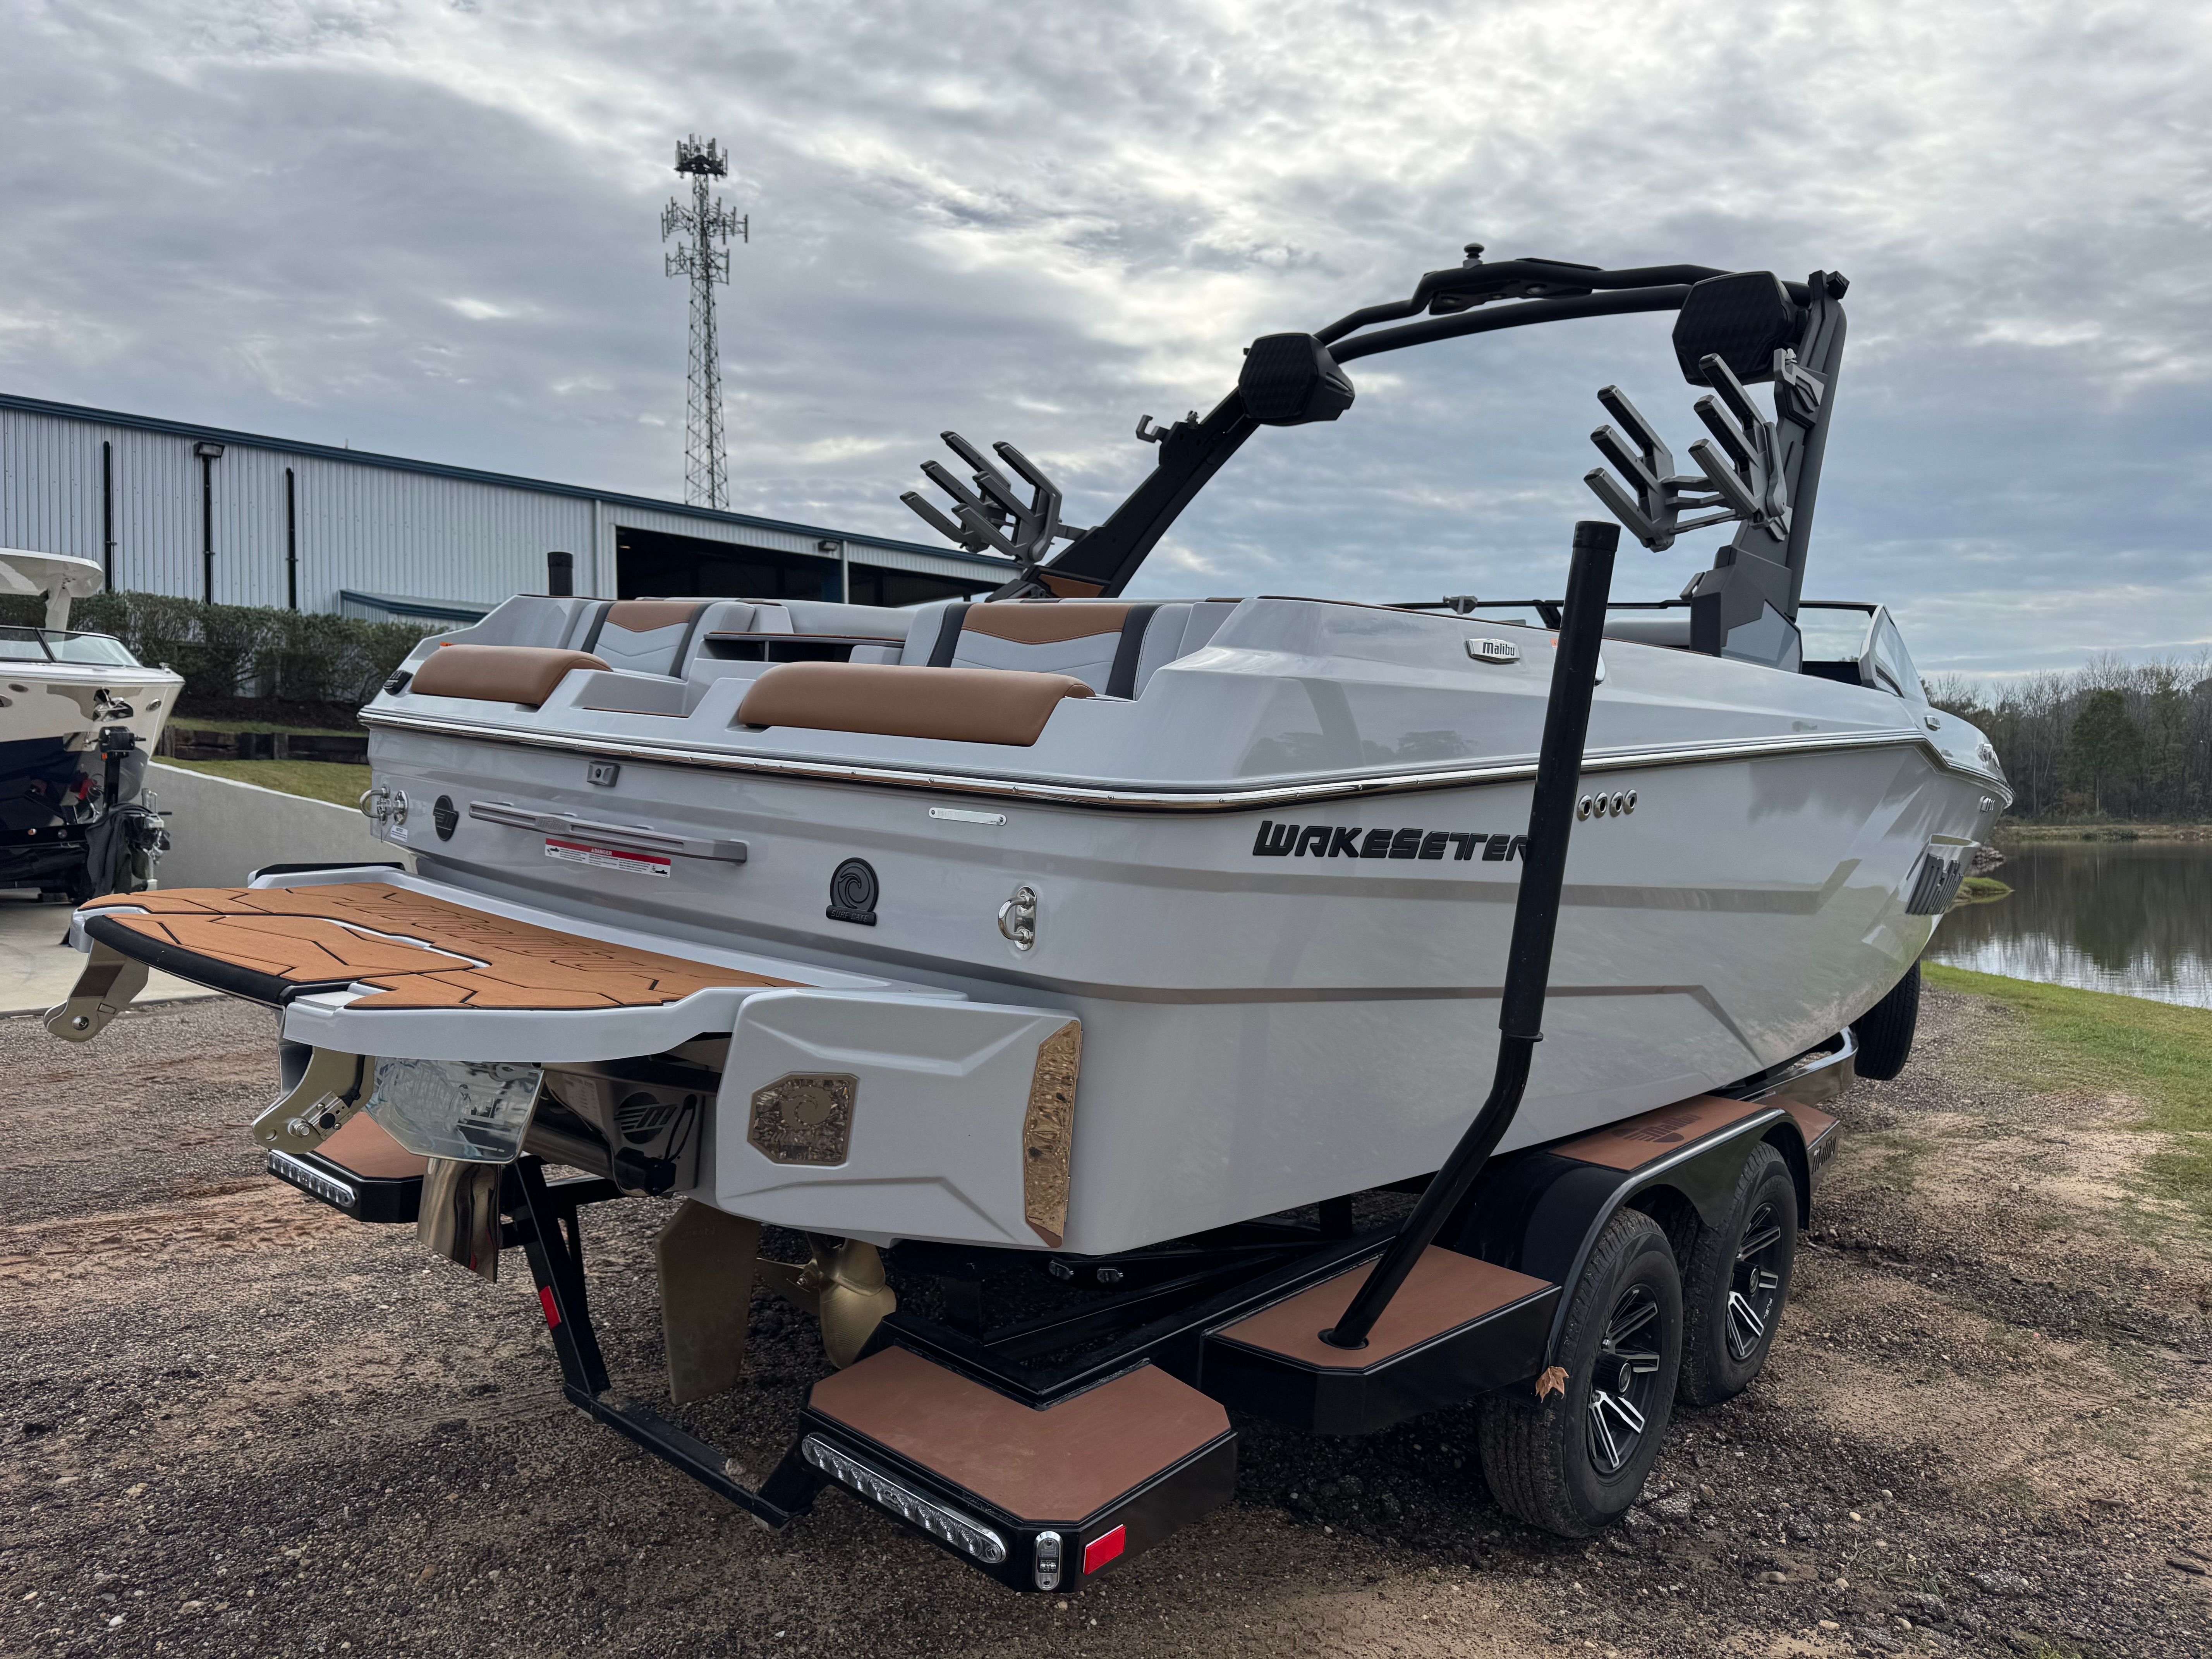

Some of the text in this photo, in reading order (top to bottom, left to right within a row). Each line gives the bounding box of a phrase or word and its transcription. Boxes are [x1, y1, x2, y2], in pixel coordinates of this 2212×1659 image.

[1482, 642, 1515, 656] Malibu
[1252, 820, 1528, 862] WAKESETTER
[830, 909, 869, 922] SURF GATE
[1639, 1113, 1704, 1138] Malibu
